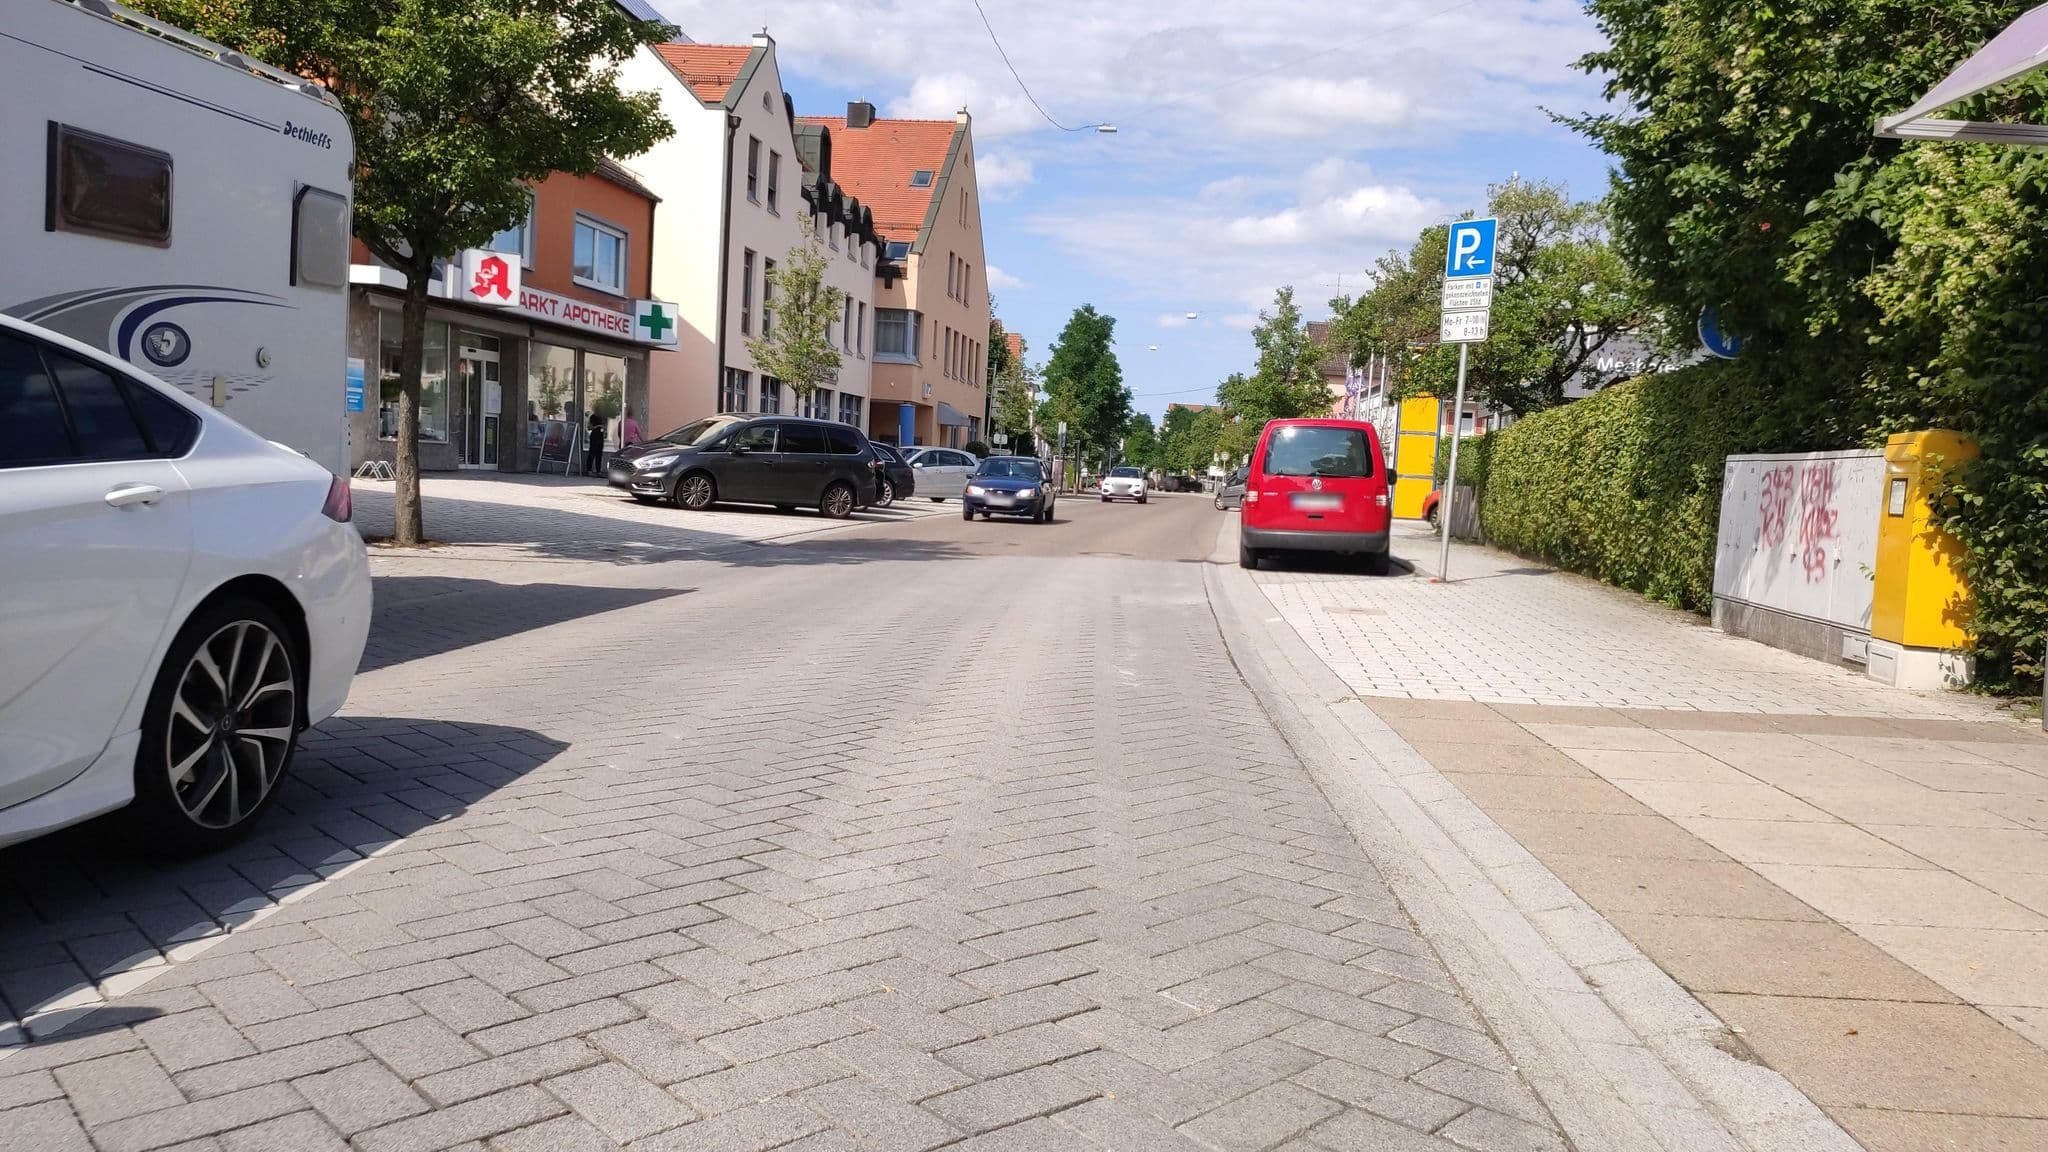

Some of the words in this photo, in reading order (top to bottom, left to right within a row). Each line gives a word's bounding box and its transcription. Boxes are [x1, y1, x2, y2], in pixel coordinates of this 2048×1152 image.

[283, 120, 332, 150] Dethleffs
[1454, 228, 1481, 271] P
[520, 291, 559, 316] ARKT
[563, 303, 630, 334] APOTHEKE
[1444, 317, 1463, 326] Mo-Fr
